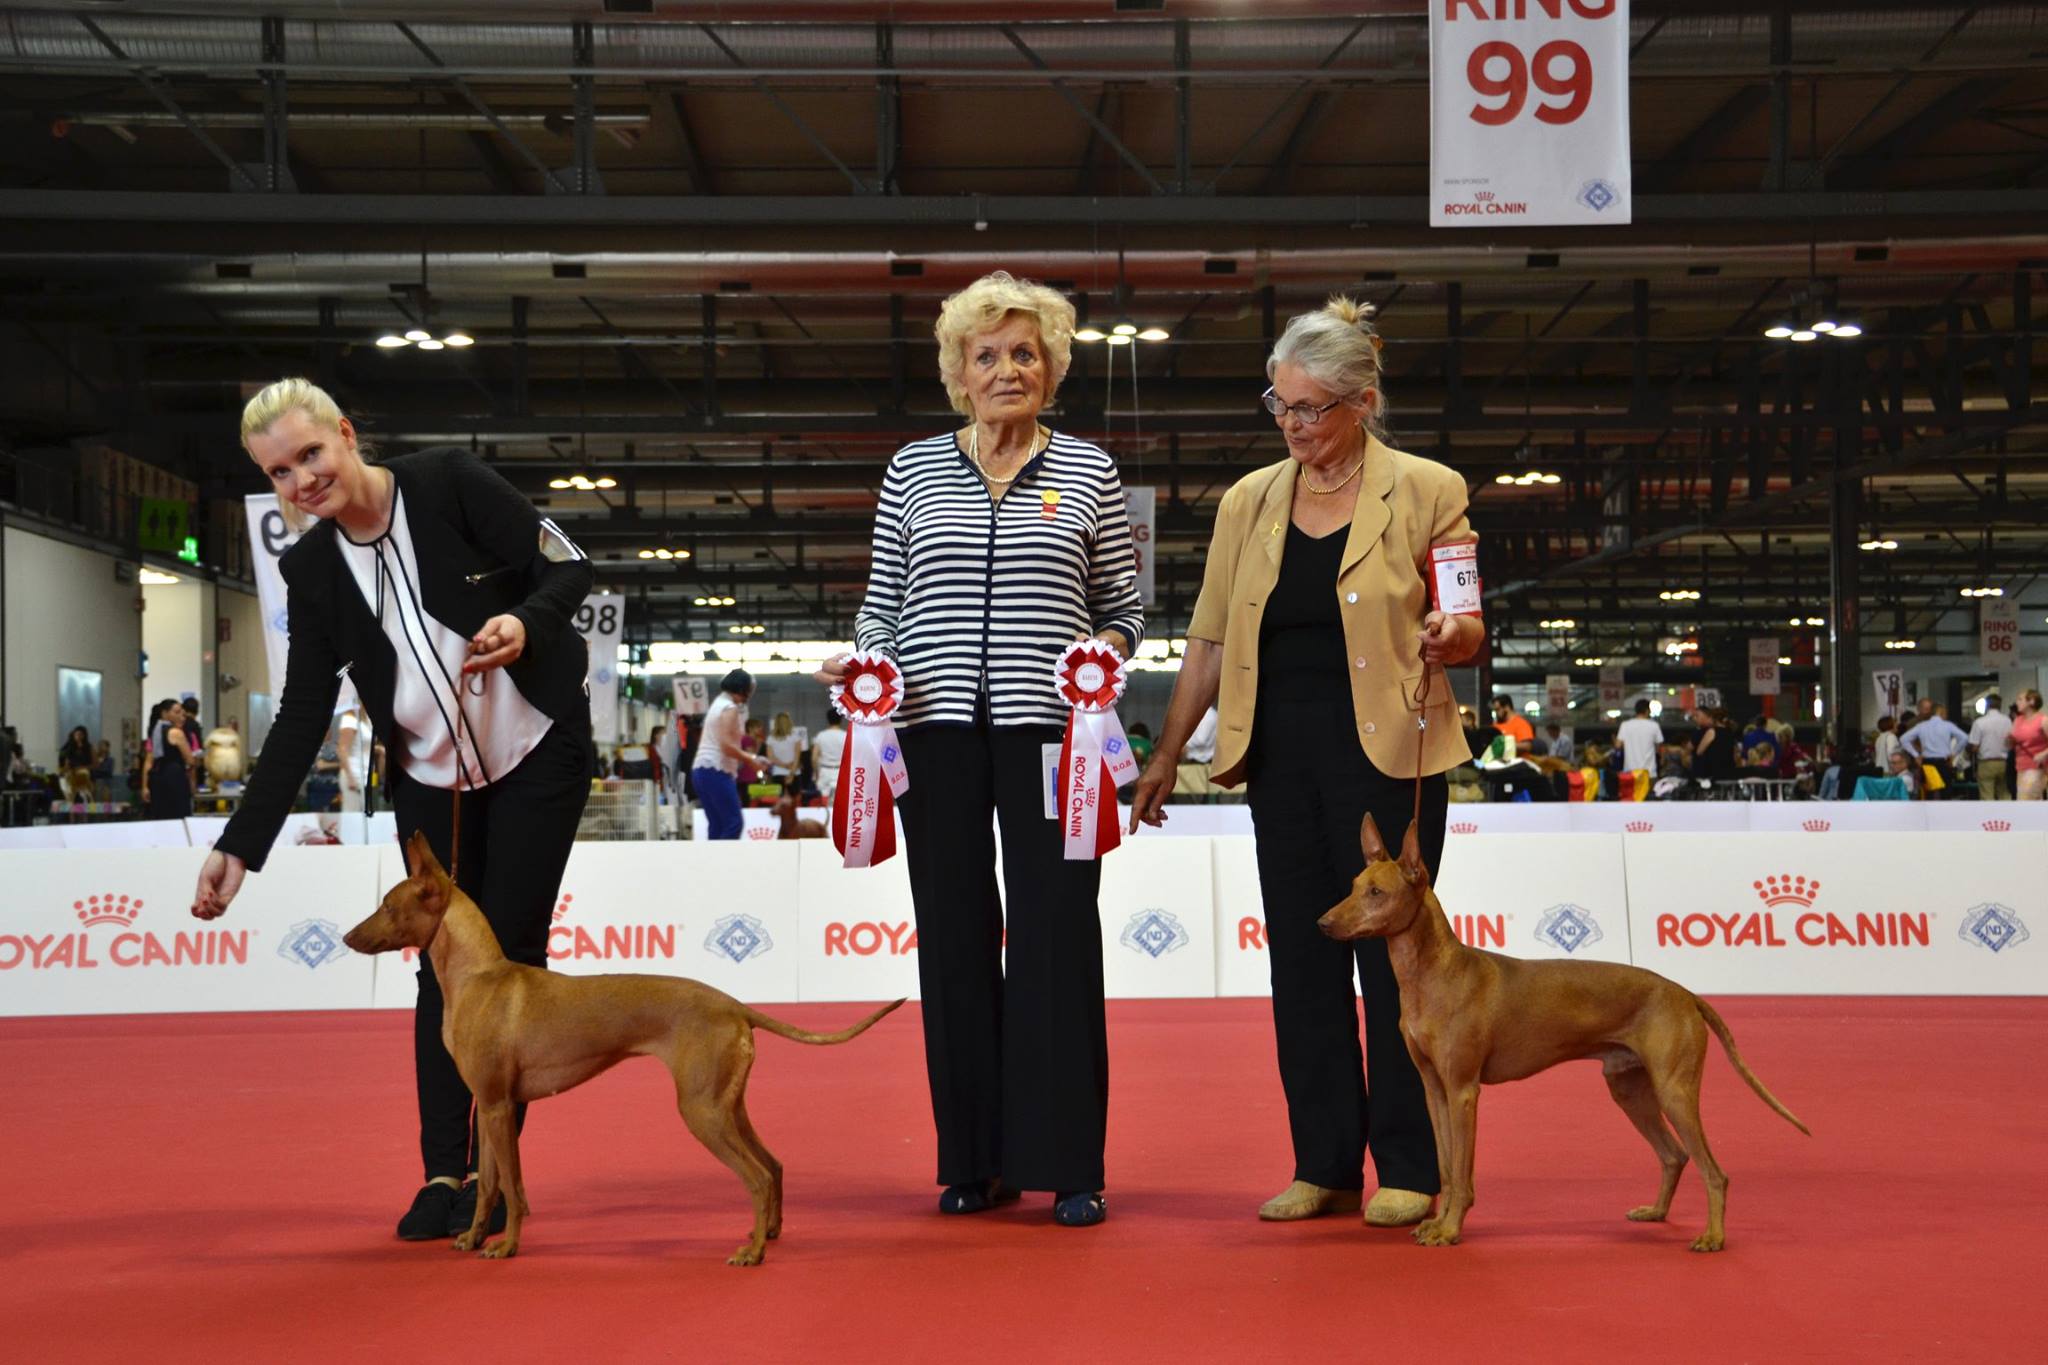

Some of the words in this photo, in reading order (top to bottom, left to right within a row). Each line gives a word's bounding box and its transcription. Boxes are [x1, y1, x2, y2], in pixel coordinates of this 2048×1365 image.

[1466, 40, 1593, 126] 99
[1444, 203, 1484, 215] ROYAL
[1486, 202, 1527, 214] CANIN
[1456, 570, 1477, 587] 679
[576, 604, 618, 635] 98
[1983, 620, 2017, 633] RING
[1988, 635, 2012, 652] 86
[852, 767, 866, 809] ROYAL
[1073, 756, 1086, 797] ROYAL
[850, 809, 863, 849] CANIN
[1070, 798, 1084, 838] CANIN
[546, 924, 675, 959] CANIN
[824, 921, 918, 956] ROYA
[1656, 912, 1786, 947] ROYAL
[1794, 912, 1930, 947] CANIN
[0, 933, 98, 970] OYAL
[109, 930, 248, 967] CANIN
